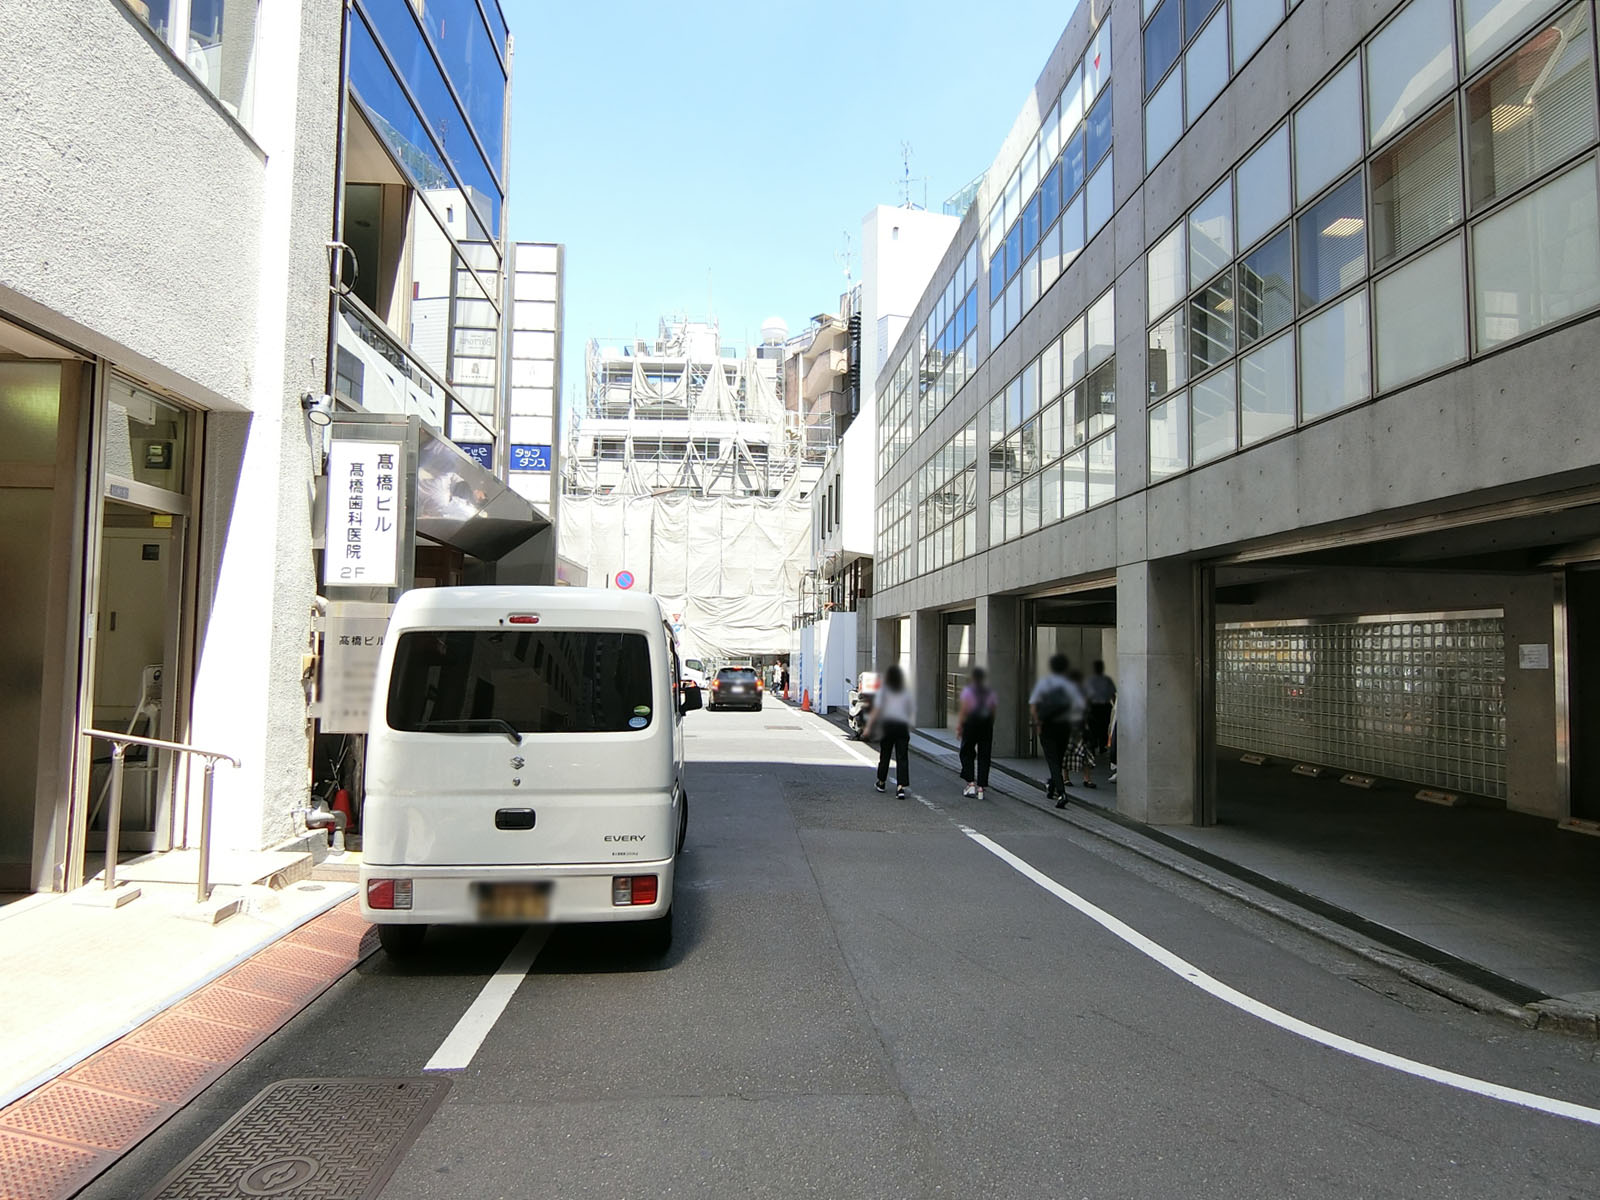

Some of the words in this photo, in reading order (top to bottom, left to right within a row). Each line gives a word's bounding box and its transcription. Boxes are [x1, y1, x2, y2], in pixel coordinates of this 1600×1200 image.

[515, 448, 541, 458] タップ
[519, 457, 547, 468] ダンス
[340, 566, 365, 579] 2F
[604, 834, 646, 842] EVERY
